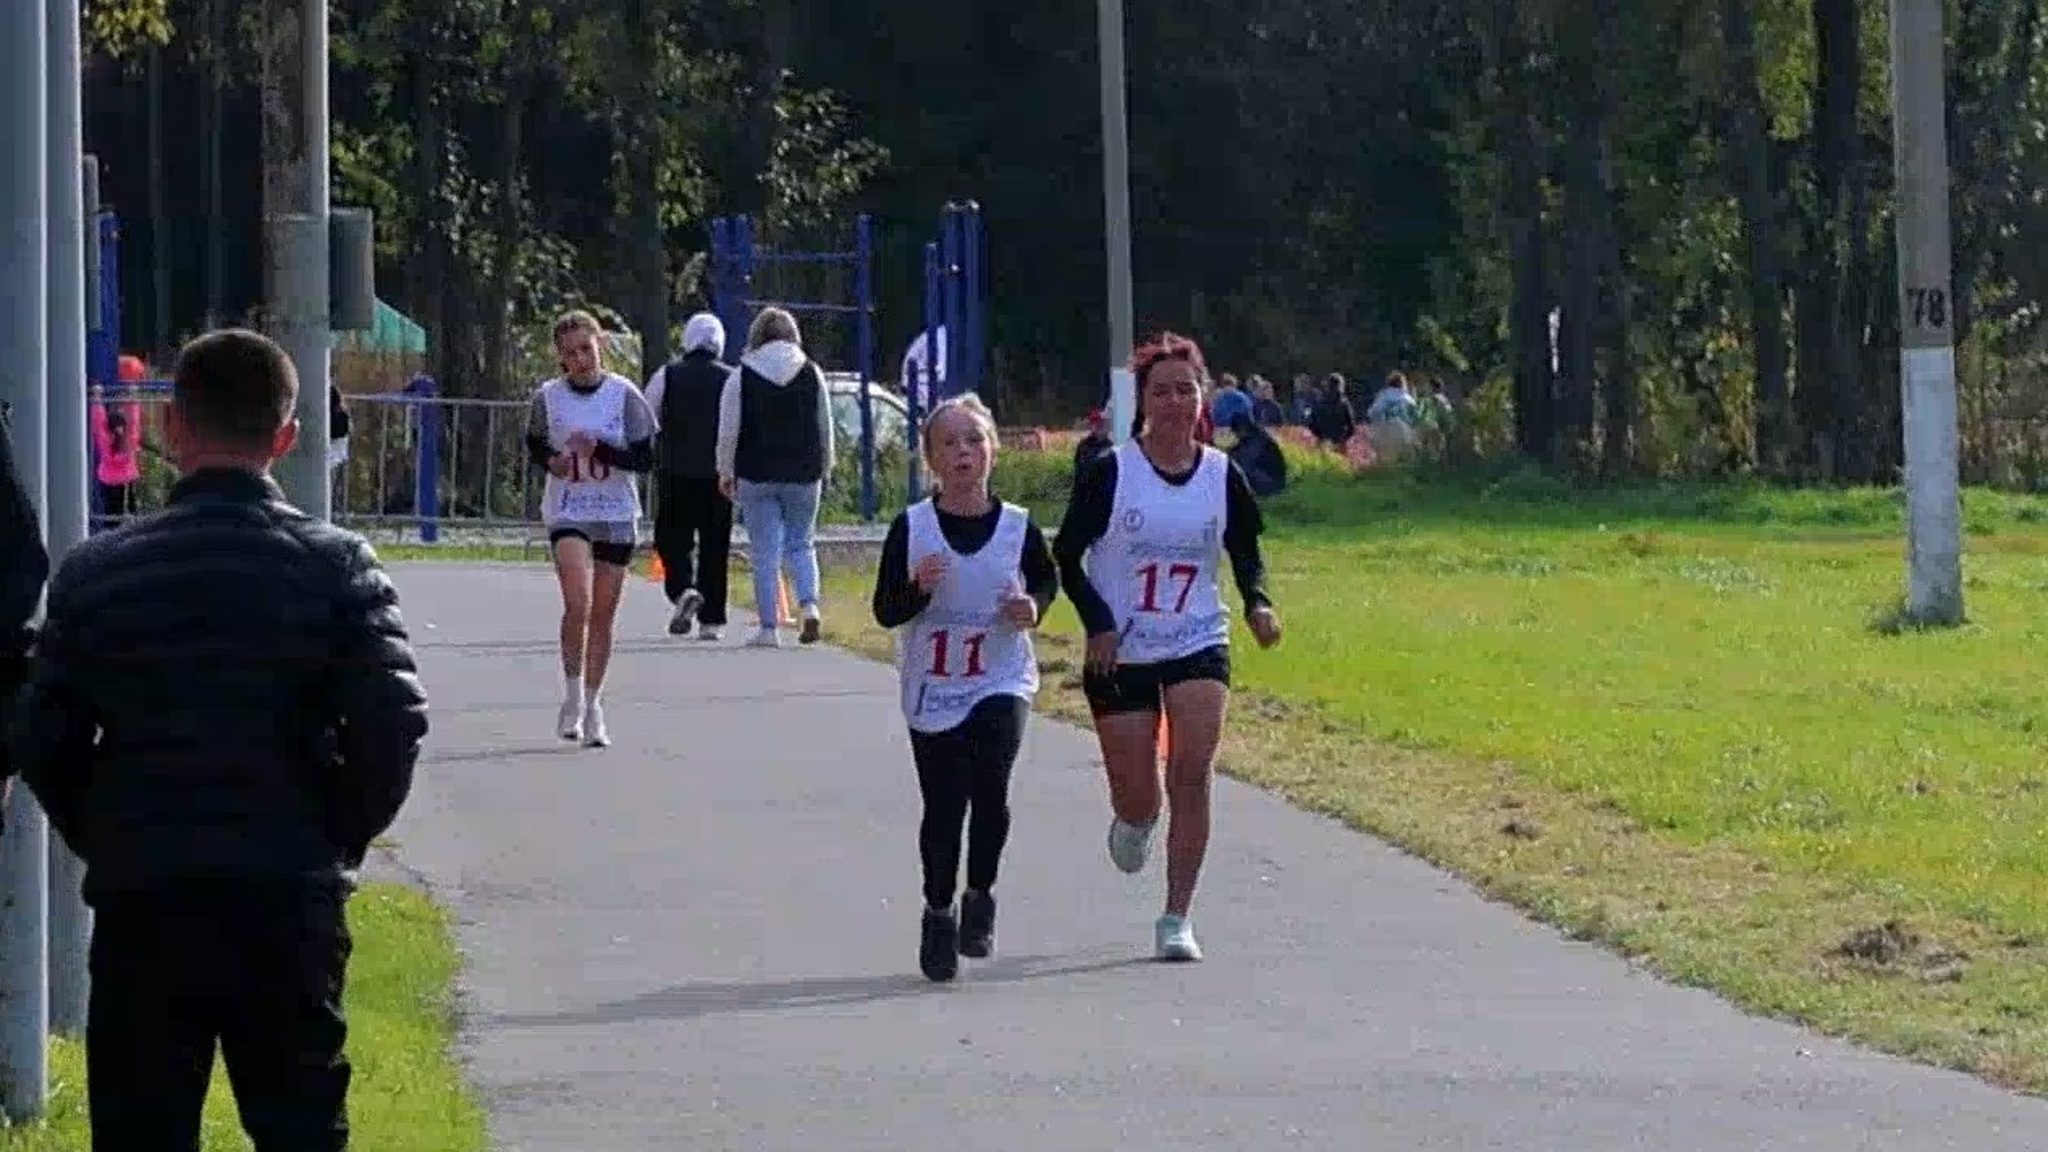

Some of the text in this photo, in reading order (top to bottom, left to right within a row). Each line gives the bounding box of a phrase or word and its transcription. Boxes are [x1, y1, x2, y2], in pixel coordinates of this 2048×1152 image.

[1906, 287, 1945, 328] 78
[1135, 561, 1199, 613] 17
[925, 629, 986, 677] 11
